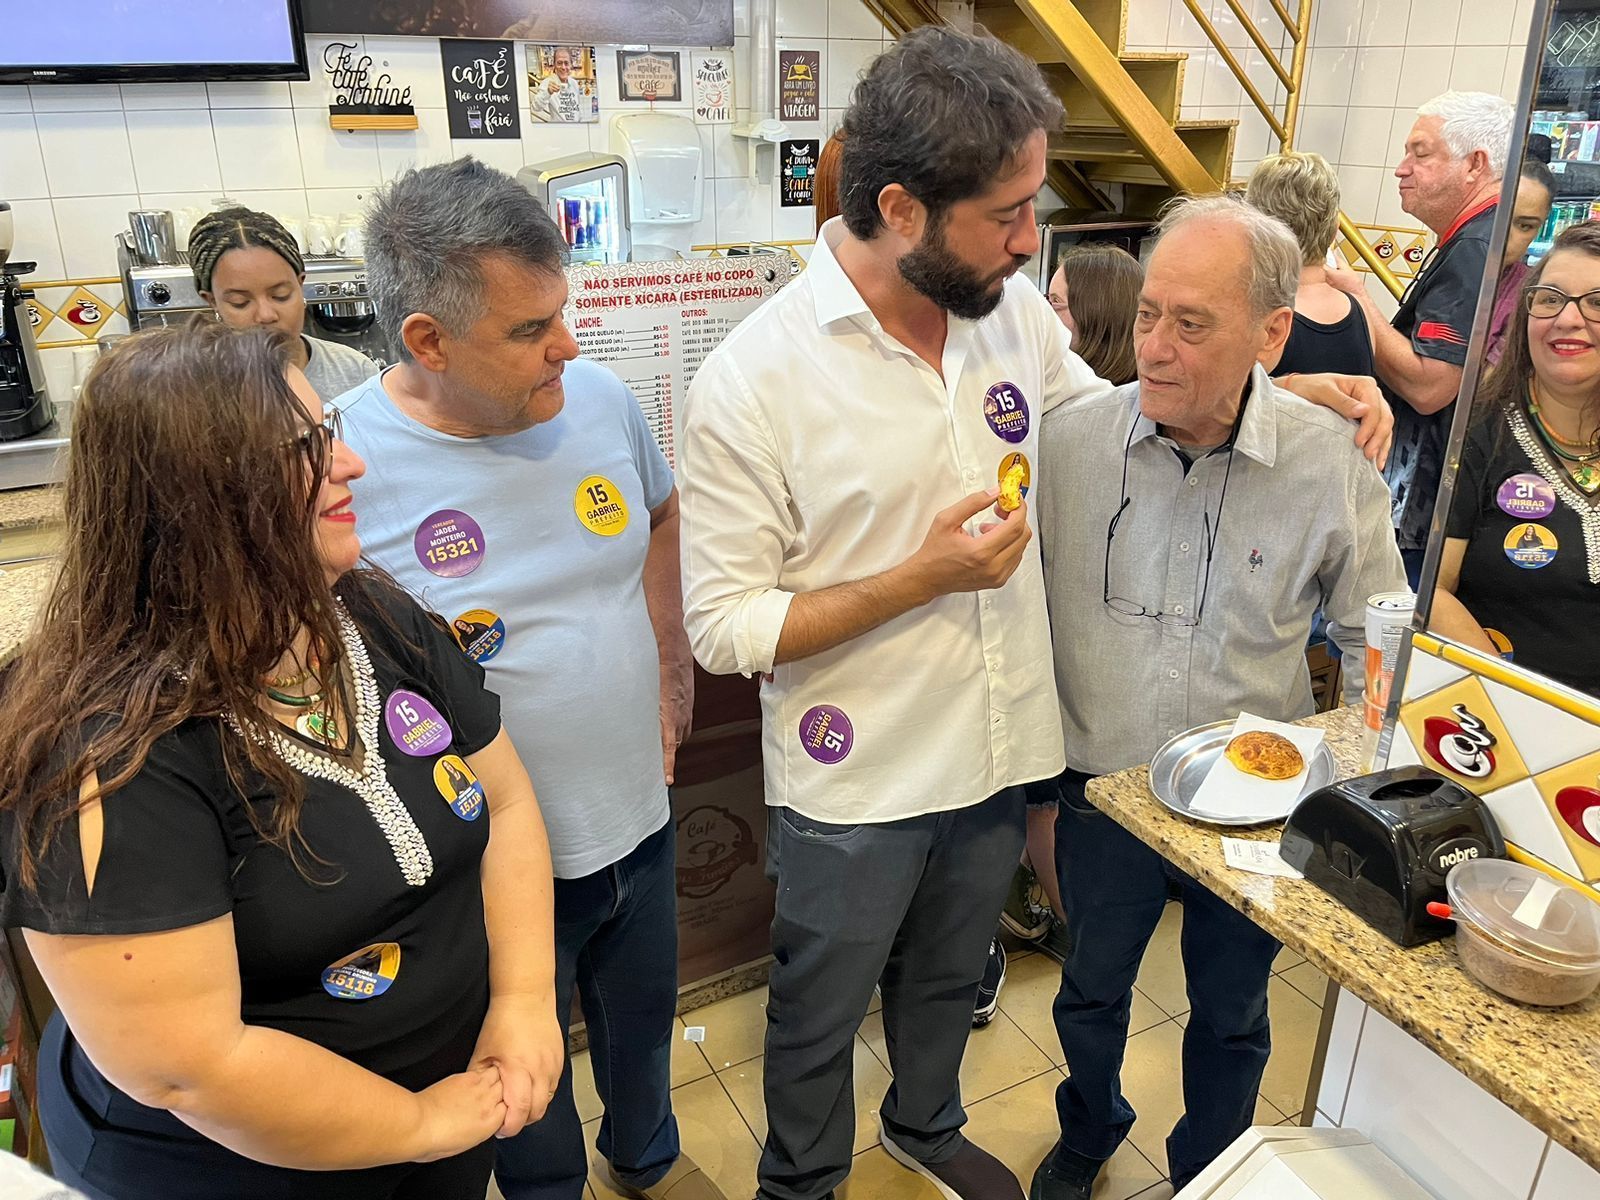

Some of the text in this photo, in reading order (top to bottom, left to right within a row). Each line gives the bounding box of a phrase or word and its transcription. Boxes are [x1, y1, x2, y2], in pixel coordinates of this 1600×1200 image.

[784, 104, 816, 118] VIAGEM
[584, 270, 754, 290] NÃO SERVIMOS CAFÉ NO COPO
[576, 286, 763, 309] SOMENTE XÍCARA (ESTERILIZADA)
[575, 317, 603, 329] LANCHE:
[681, 309, 708, 317] OUTROS:
[995, 390, 1015, 411] 15
[995, 410, 1025, 424] GABRIEL
[587, 484, 608, 505] 15
[586, 503, 621, 519] GABRIEL
[430, 531, 466, 547] MONTEIRO
[434, 524, 457, 536] JADER
[426, 537, 478, 564] 15321
[471, 631, 501, 660] 15118
[395, 699, 419, 727] 15
[402, 718, 438, 744] GABRIEL
[812, 713, 832, 749] GABRIEL
[824, 729, 845, 752] 15
[460, 792, 482, 816] 15118
[1440, 847, 1479, 868] nobre
[327, 973, 375, 995] 15118
